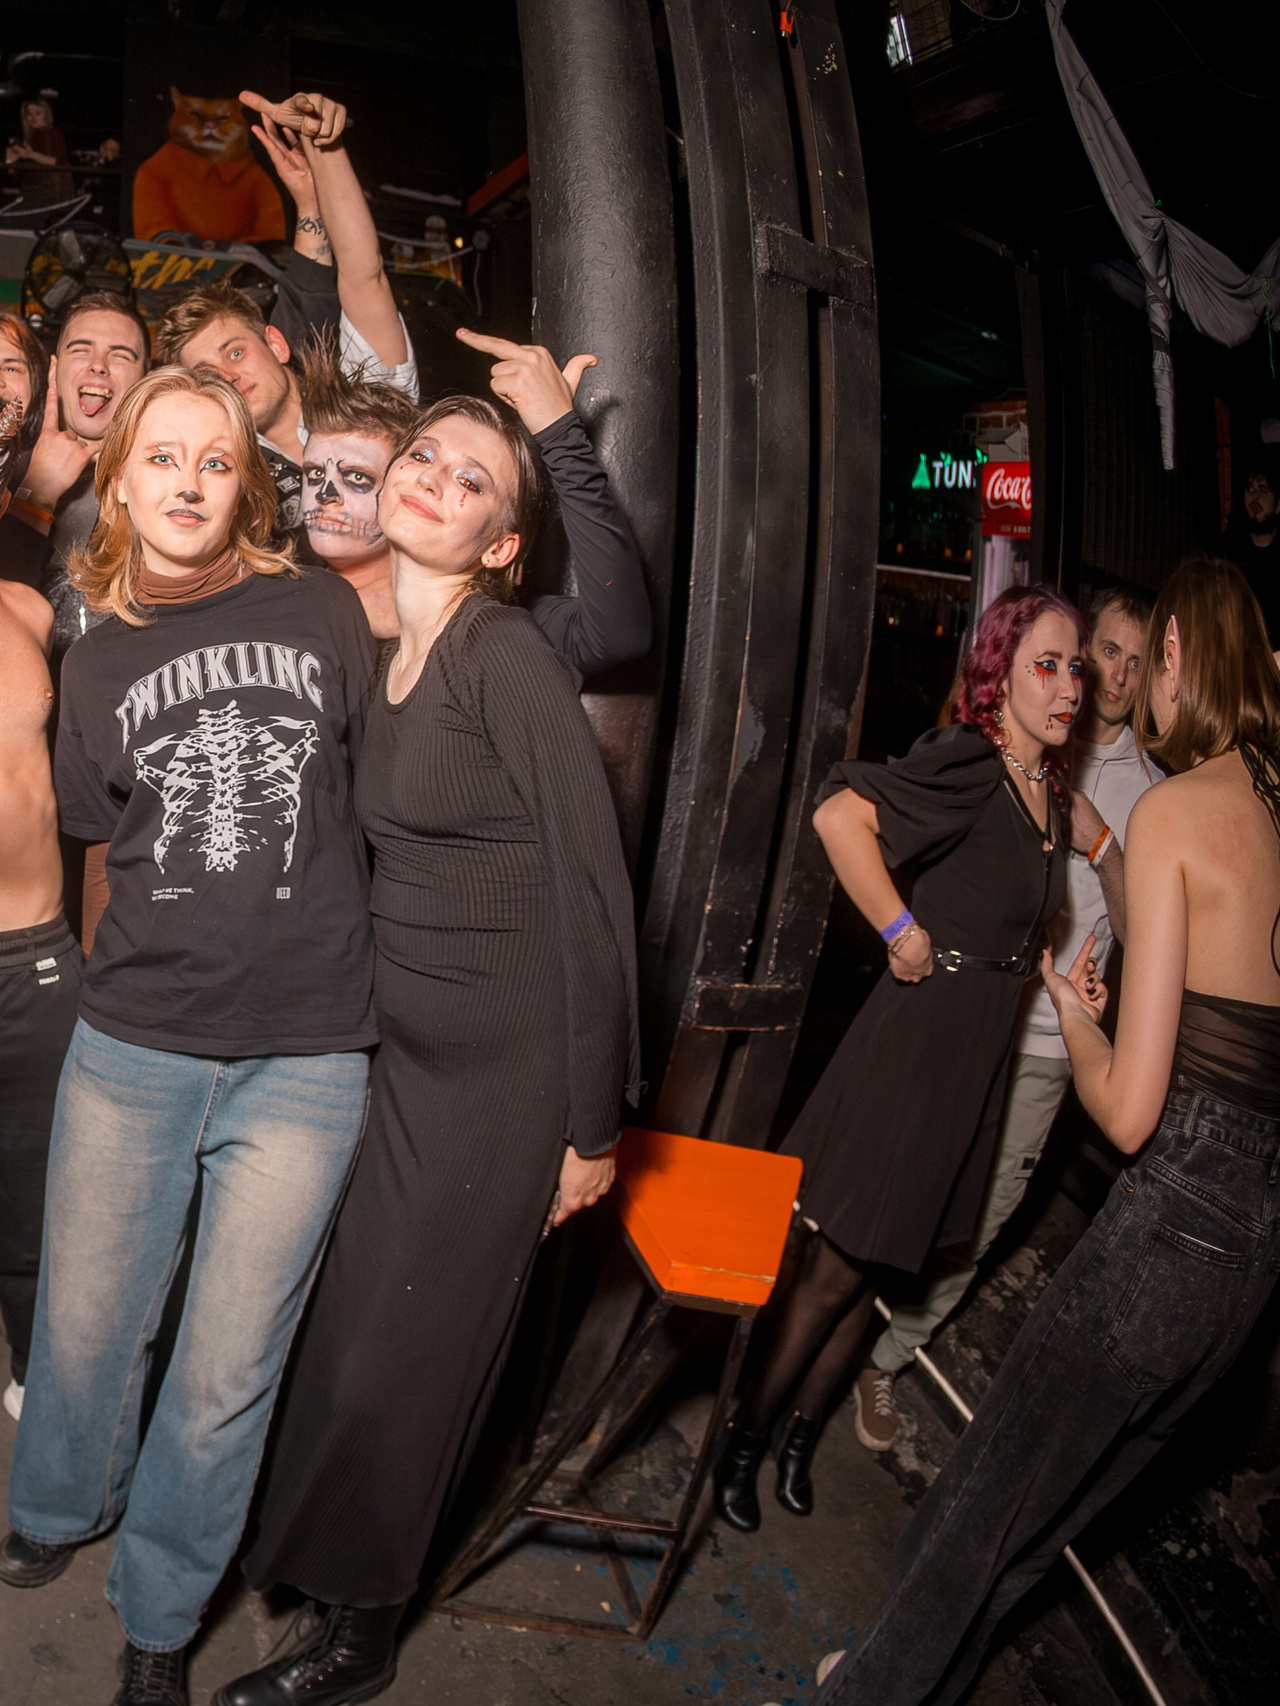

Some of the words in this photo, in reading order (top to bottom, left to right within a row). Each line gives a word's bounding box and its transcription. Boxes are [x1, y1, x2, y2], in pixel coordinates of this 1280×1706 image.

[932, 460, 977, 489] TUN
[986, 468, 1031, 510] Coca-C
[115, 642, 324, 754] TWINKLING
